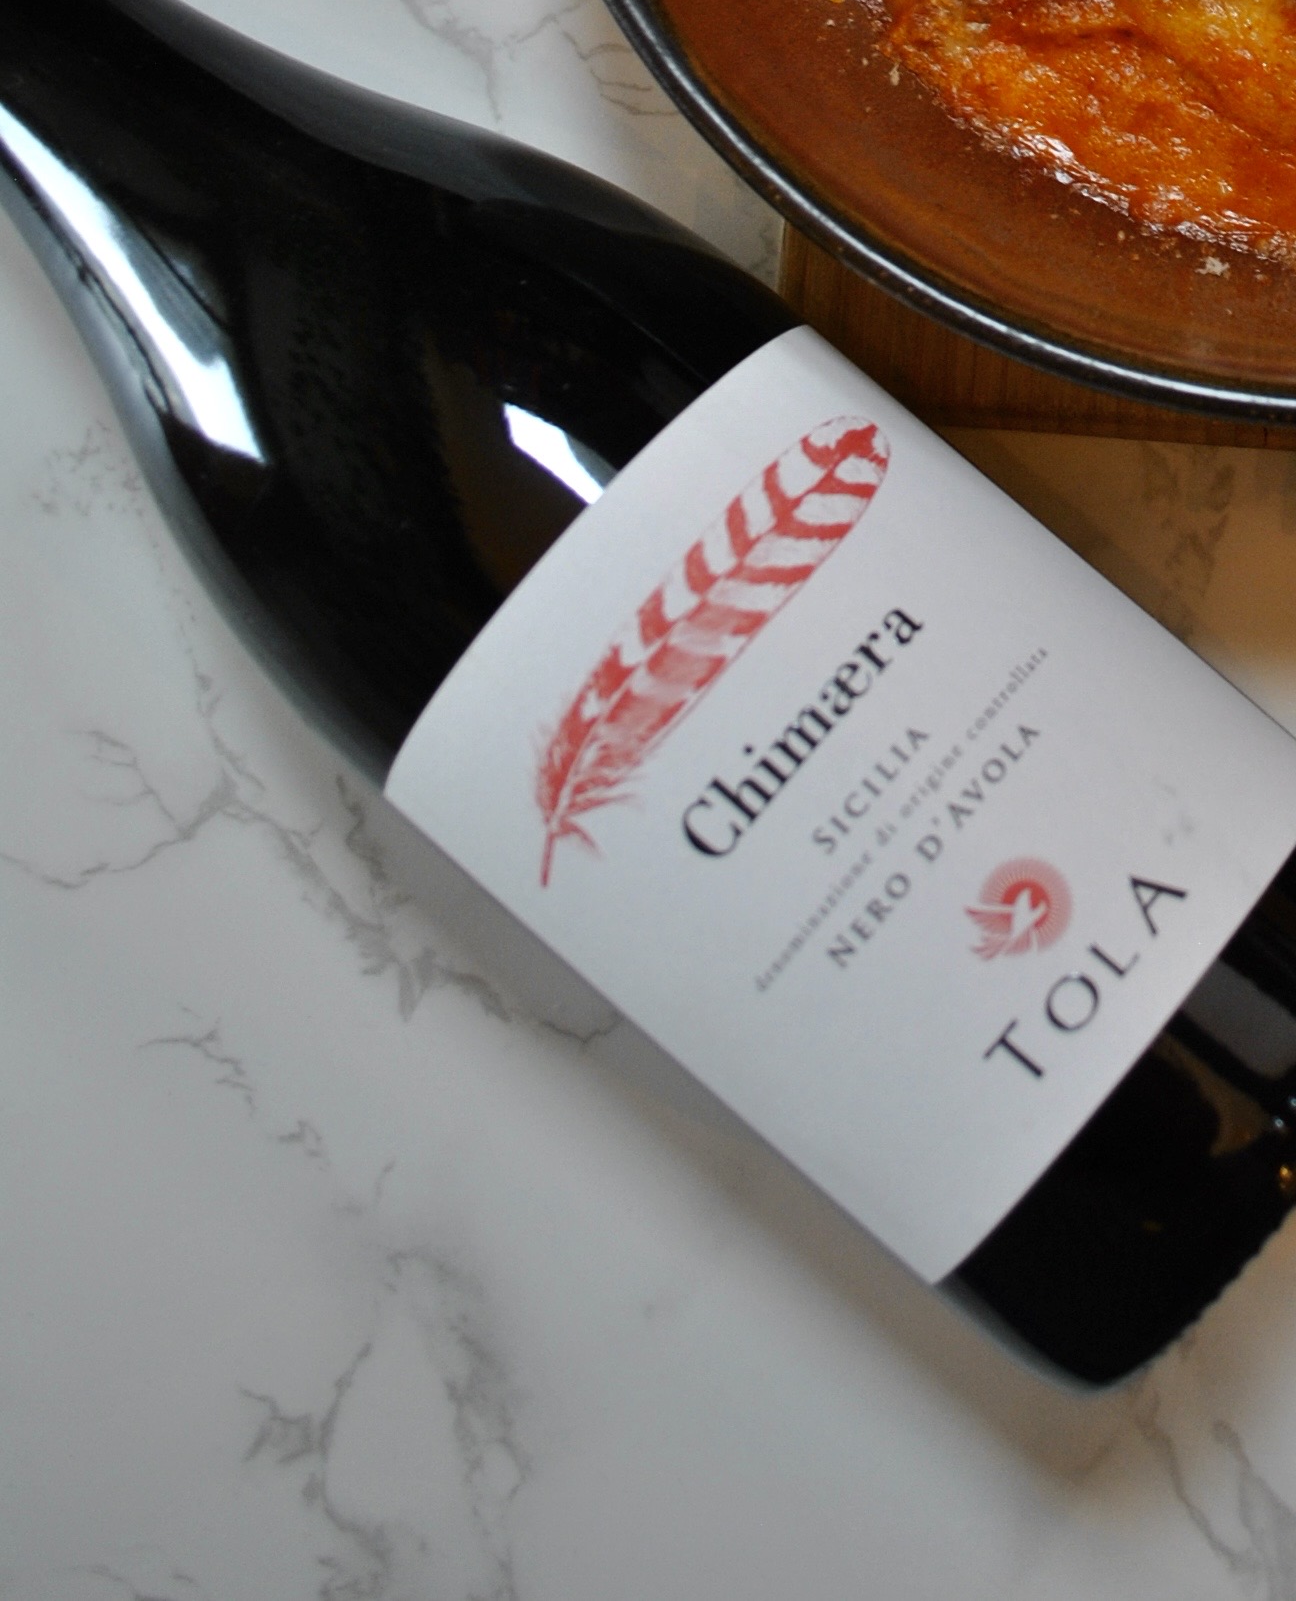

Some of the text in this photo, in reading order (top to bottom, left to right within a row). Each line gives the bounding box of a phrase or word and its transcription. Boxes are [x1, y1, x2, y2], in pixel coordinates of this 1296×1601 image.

[680, 606, 925, 860] Chimæra
[755, 646, 1049, 993] denominazione di origine controllata
[811, 727, 930, 855] SICILIA
[825, 724, 1041, 969] NERO D'AVOLA
[982, 874, 1189, 1081] TOLA
